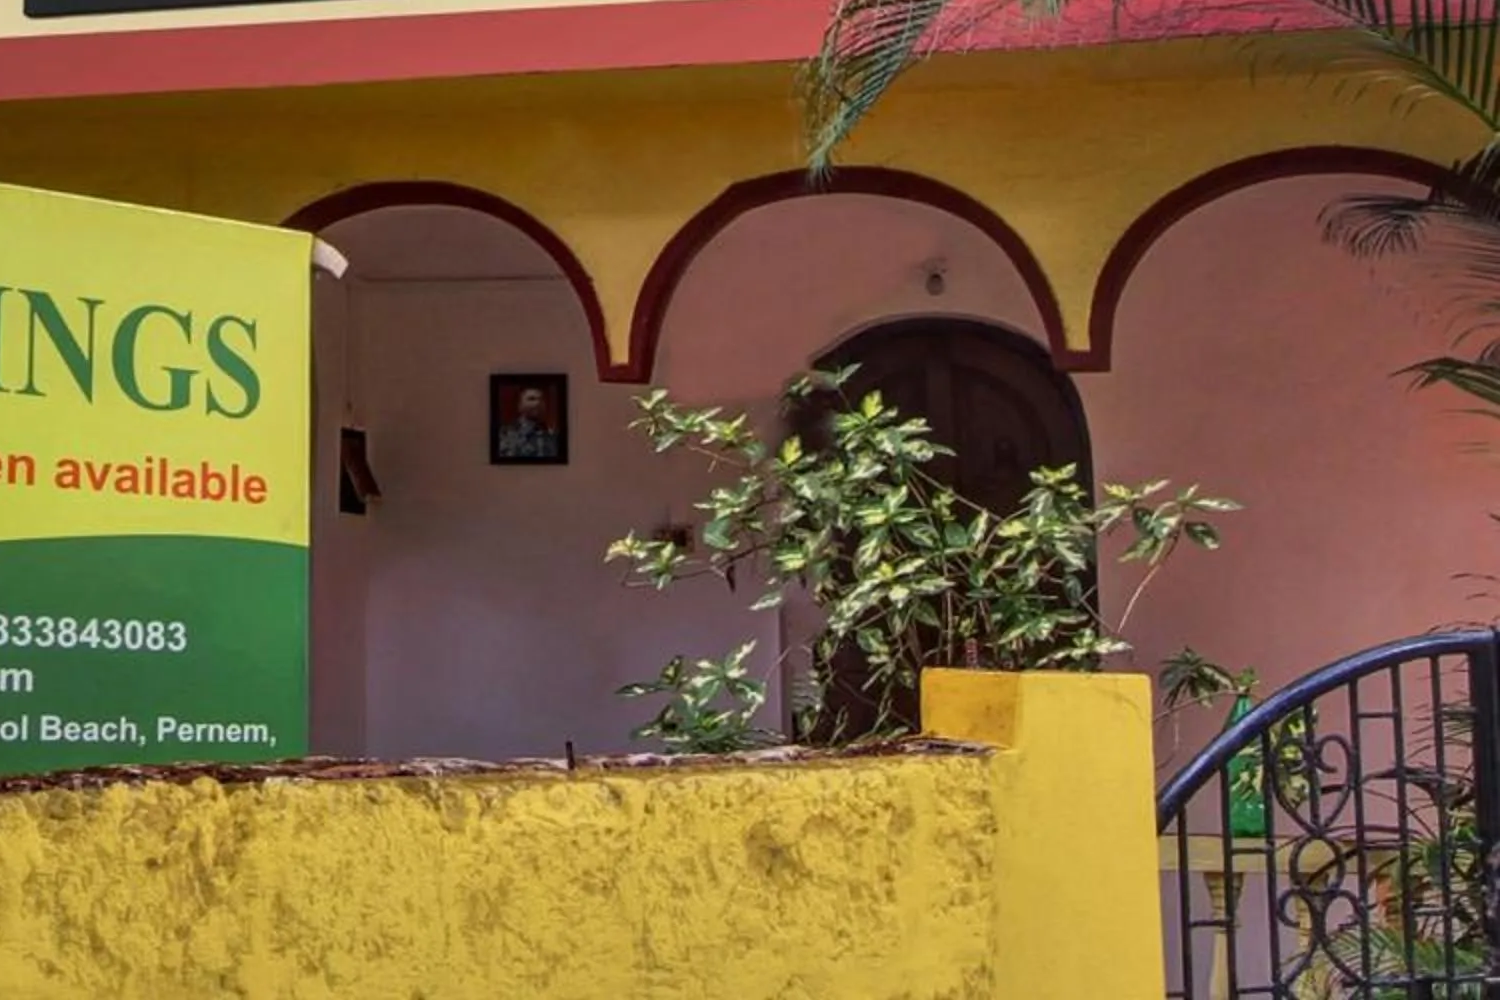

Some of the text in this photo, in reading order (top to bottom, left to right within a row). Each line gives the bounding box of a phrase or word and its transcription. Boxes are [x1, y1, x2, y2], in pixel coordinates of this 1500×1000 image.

[55, 457, 268, 503] available
[40, 714, 146, 746] Beach,
[157, 716, 277, 747] Pernem,
